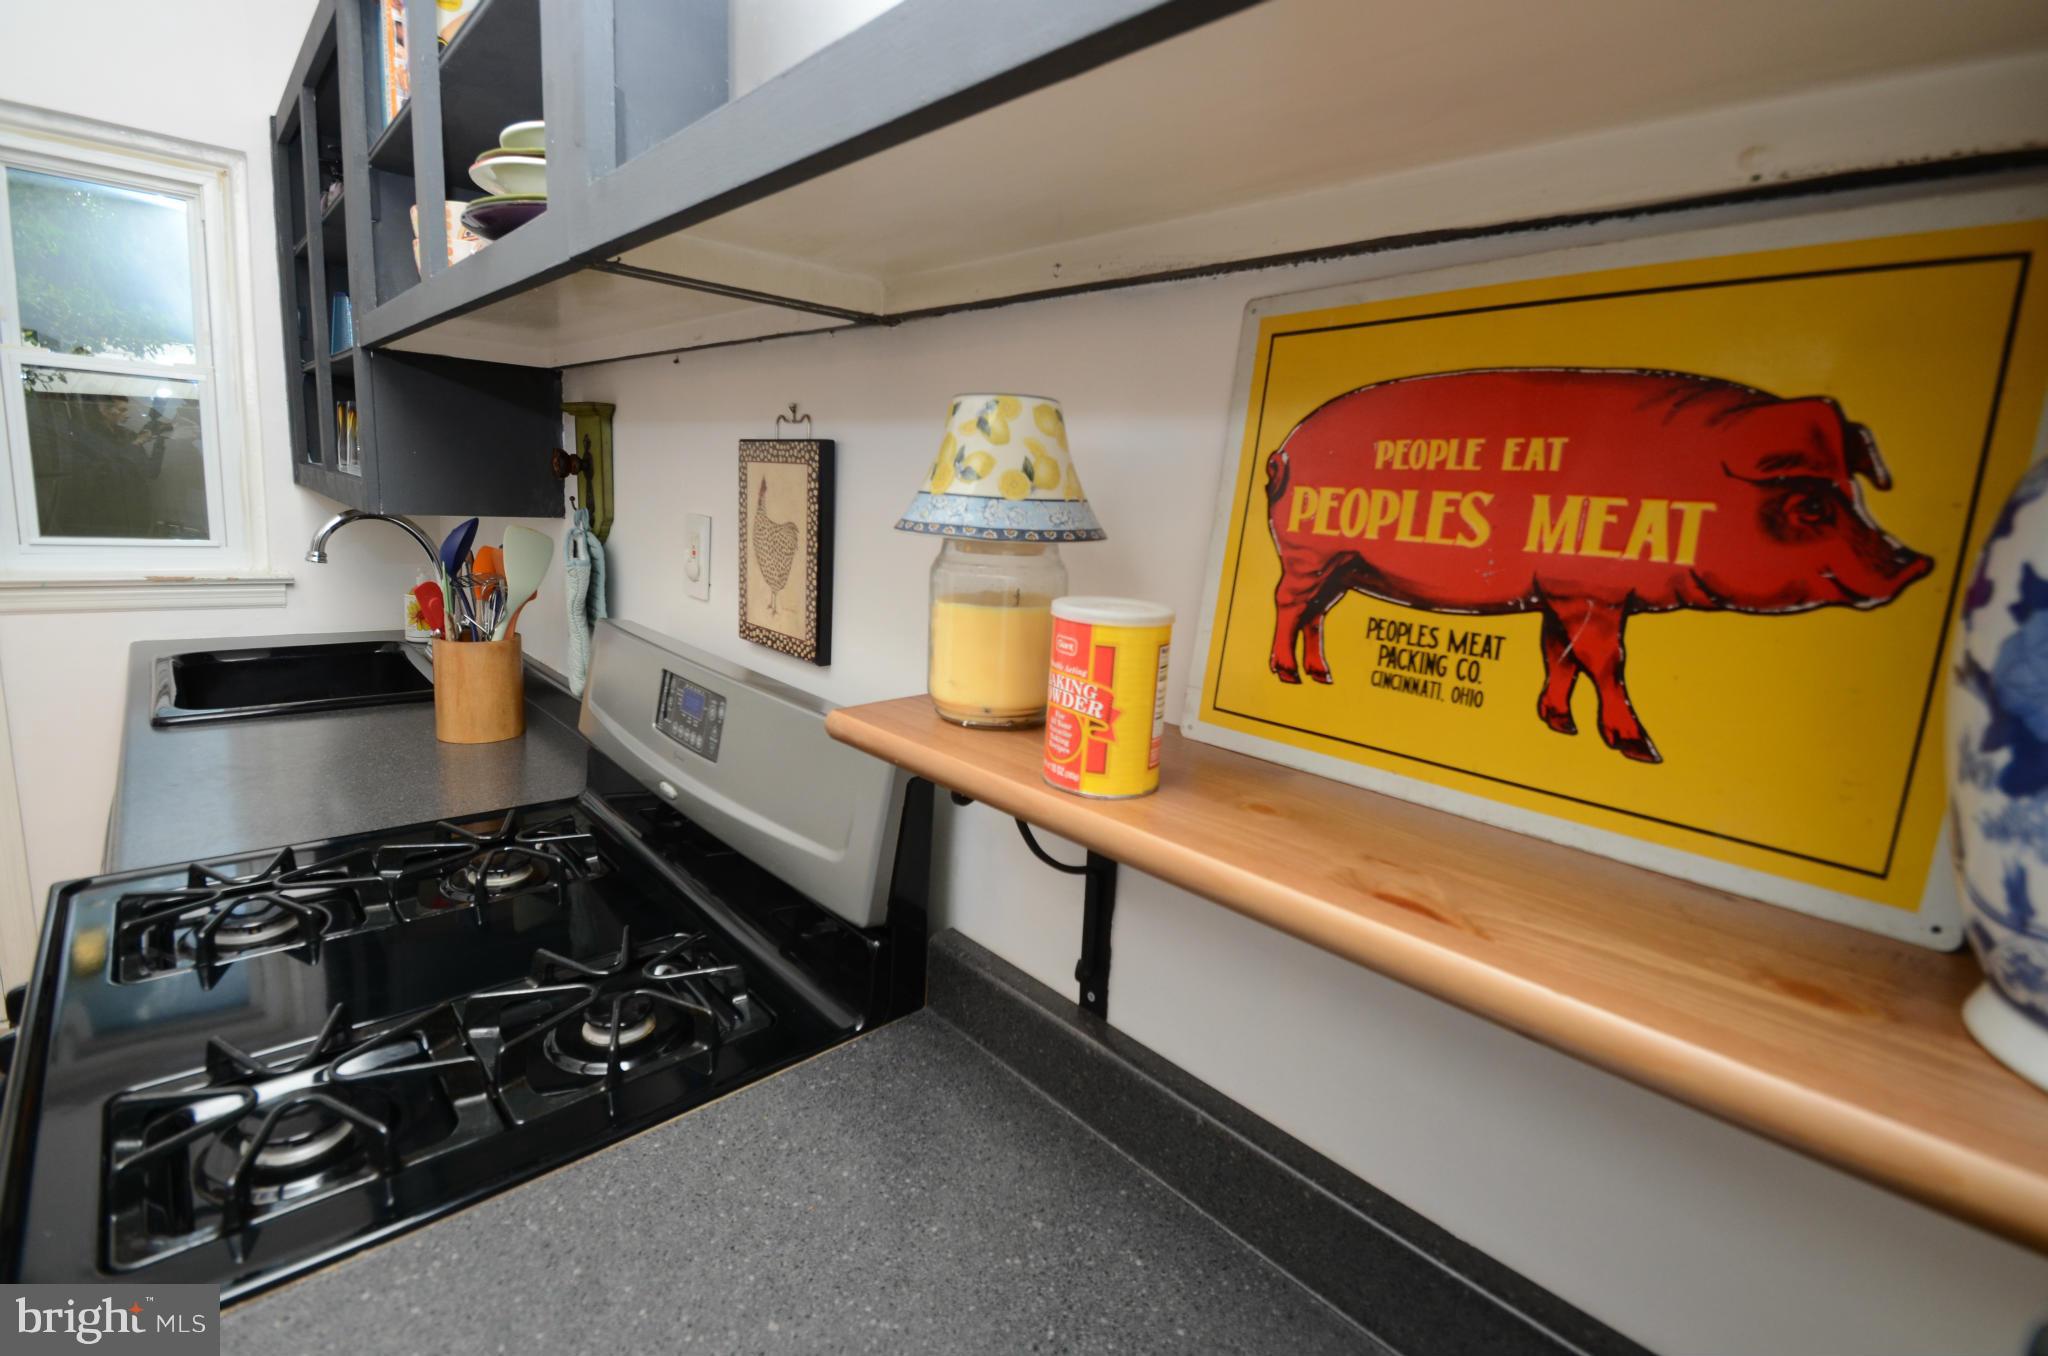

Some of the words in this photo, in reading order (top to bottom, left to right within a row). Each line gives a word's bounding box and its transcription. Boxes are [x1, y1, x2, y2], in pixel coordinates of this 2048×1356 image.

[1374, 438, 1486, 471] PEOPLE
[1501, 437, 1569, 472] EAT
[1287, 486, 1494, 548] PEOPLES
[1522, 494, 1717, 566] MEAT
[1366, 617, 1439, 649] PEOPLES
[1447, 629, 1506, 660] MEAT
[1377, 645, 1448, 677] PACKING
[1456, 658, 1482, 684] CO.
[1049, 673, 1099, 699] AKING
[1451, 686, 1484, 708] OHIO
